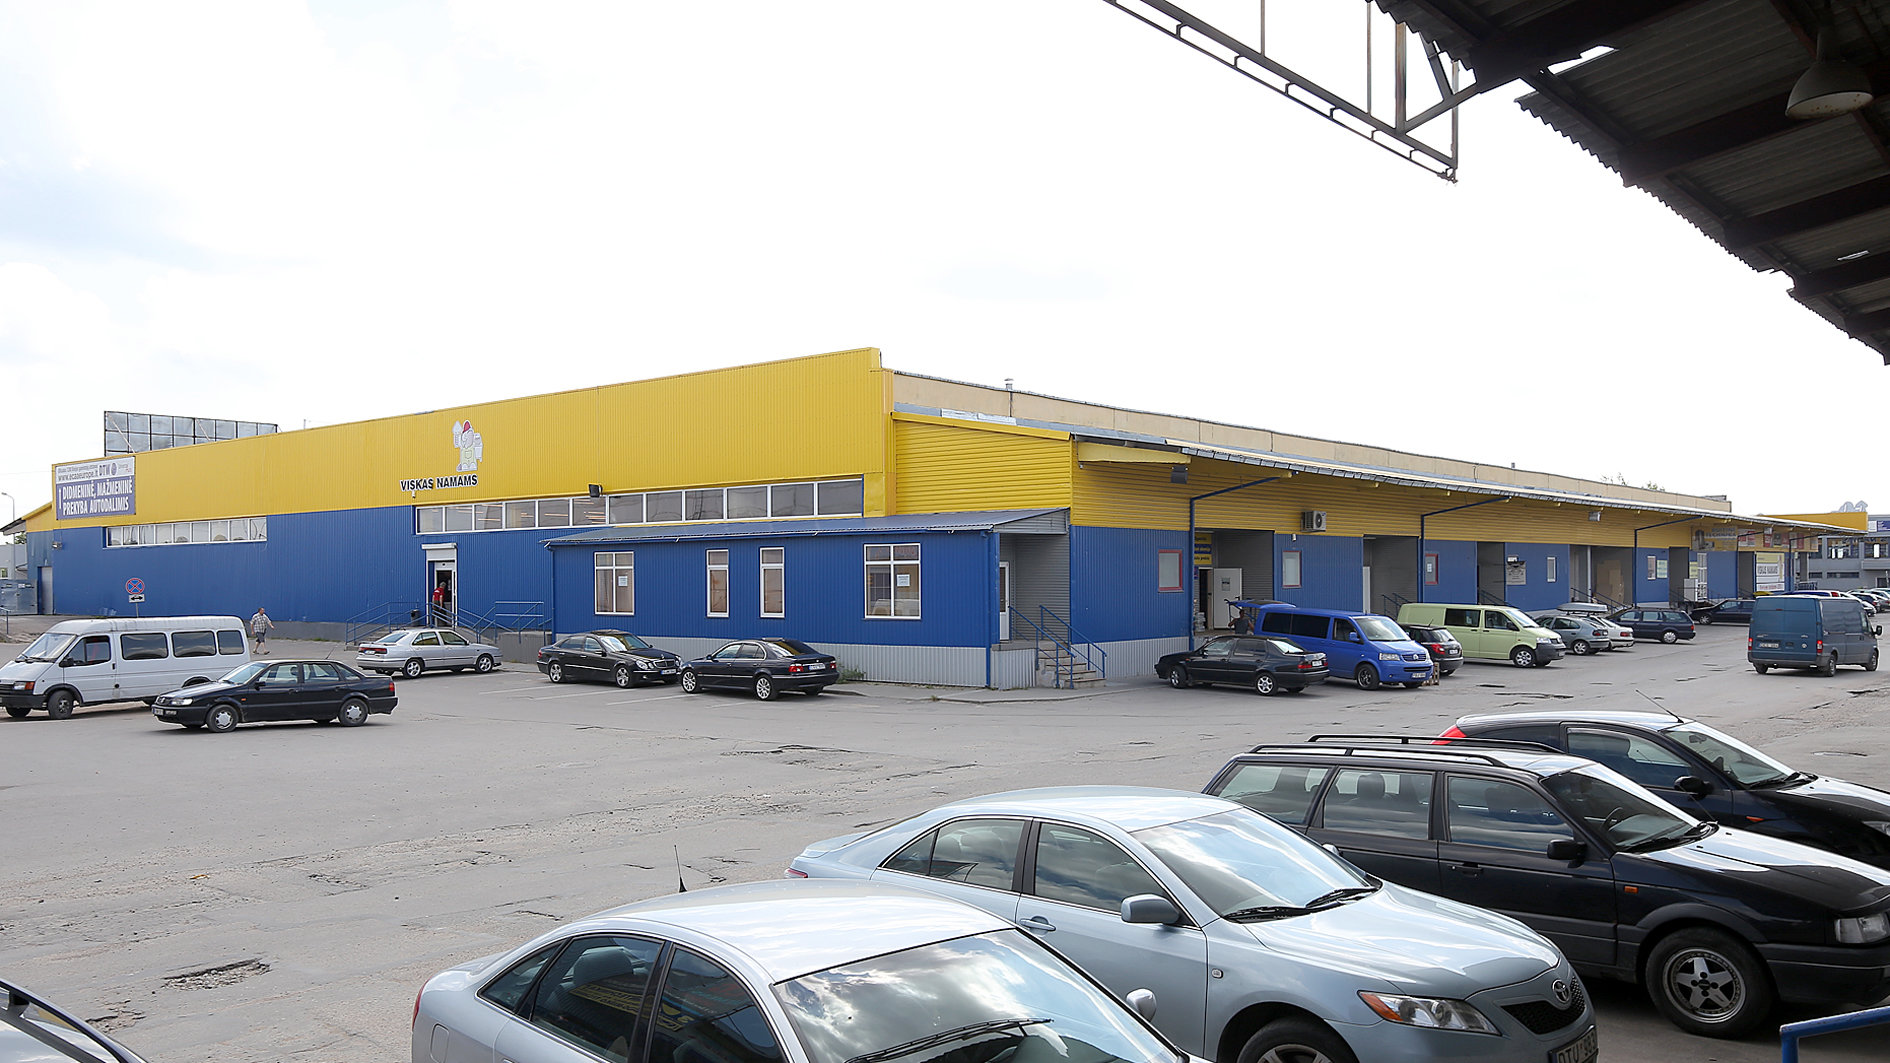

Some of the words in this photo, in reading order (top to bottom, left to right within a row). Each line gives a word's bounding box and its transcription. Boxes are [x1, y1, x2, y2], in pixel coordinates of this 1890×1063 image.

[97, 477, 133, 496] MAŽMENINĖ
[400, 478, 433, 491] VISKAS
[436, 475, 478, 488] NAMAMS
[62, 500, 88, 516] PREKYBA
[89, 496, 129, 513] AUTODALIMIS
